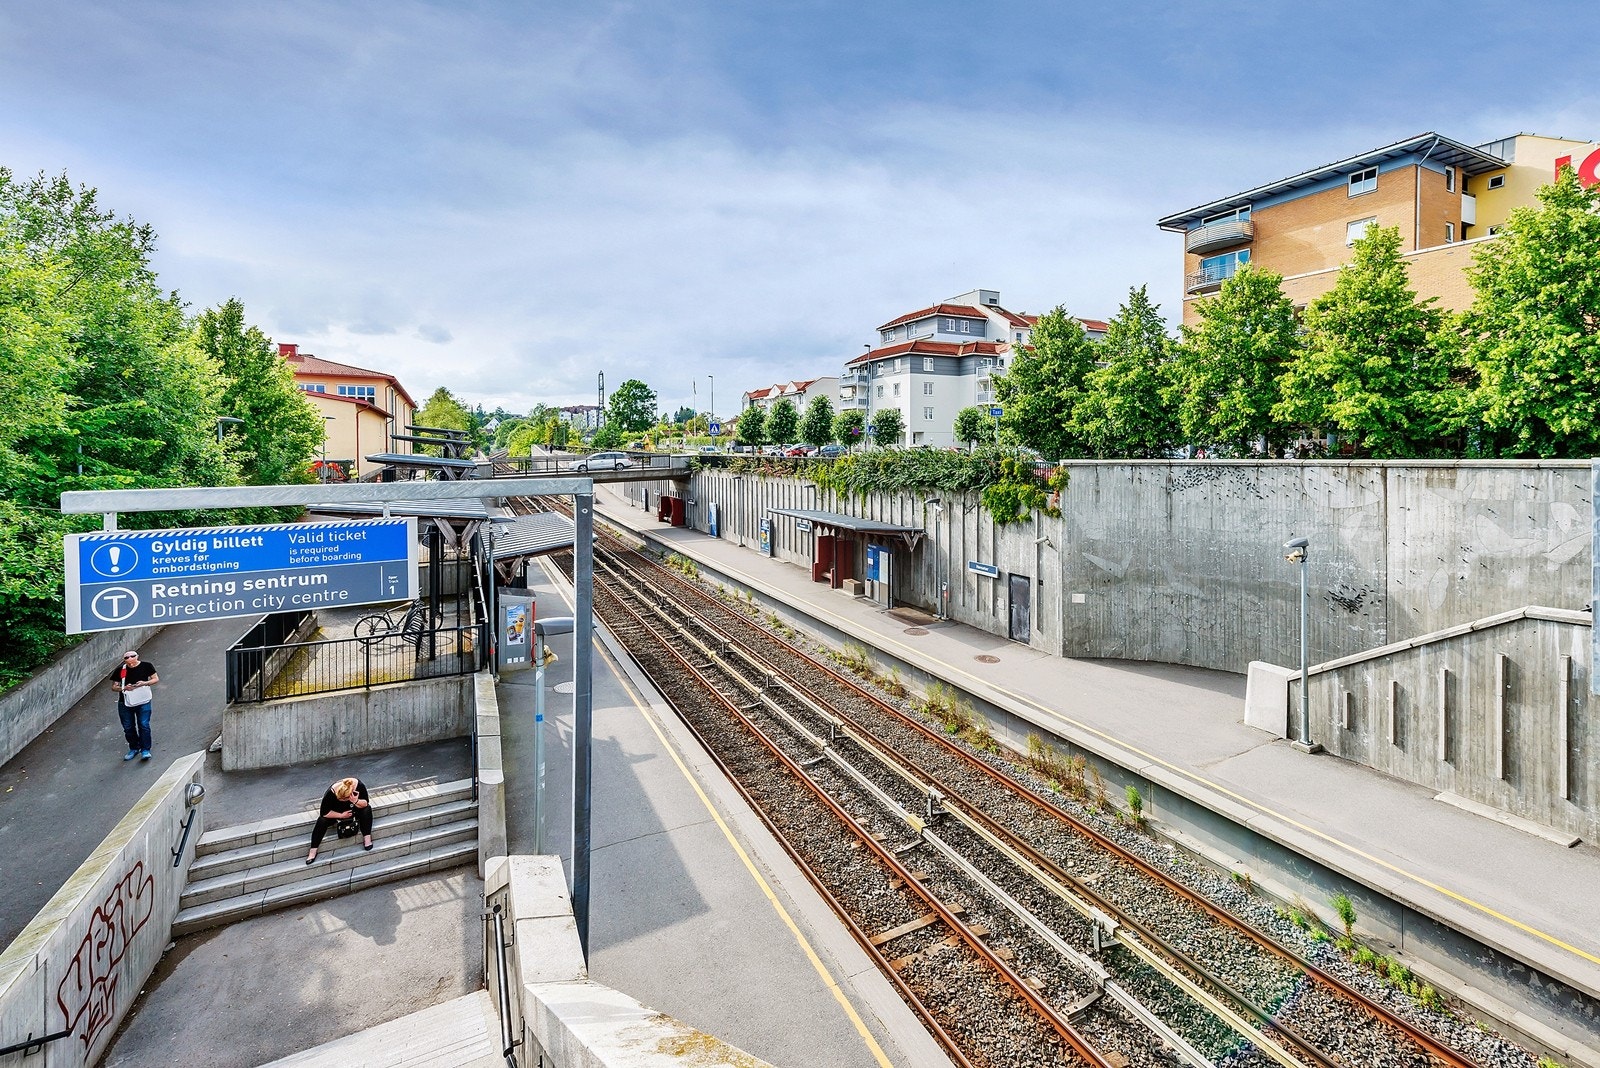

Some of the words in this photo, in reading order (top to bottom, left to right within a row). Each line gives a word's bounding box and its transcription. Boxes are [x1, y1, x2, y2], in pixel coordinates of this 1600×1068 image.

[288, 532, 324, 544] Valid
[328, 530, 367, 542] ticket
[151, 539, 207, 555] Gyldig
[213, 536, 264, 549] billett
[289, 547, 298, 555] is
[299, 545, 339, 555] required
[152, 555, 191, 565] kreves
[193, 553, 210, 562] før
[289, 555, 320, 564] before
[322, 552, 362, 562] boarding
[152, 561, 240, 574] ombordstigning
[151, 580, 236, 599] Retning
[243, 573, 328, 591] sentrum
[389, 585, 395, 595] 1
[152, 599, 245, 618] Direction
[252, 594, 286, 609] city
[291, 589, 349, 605] centre
